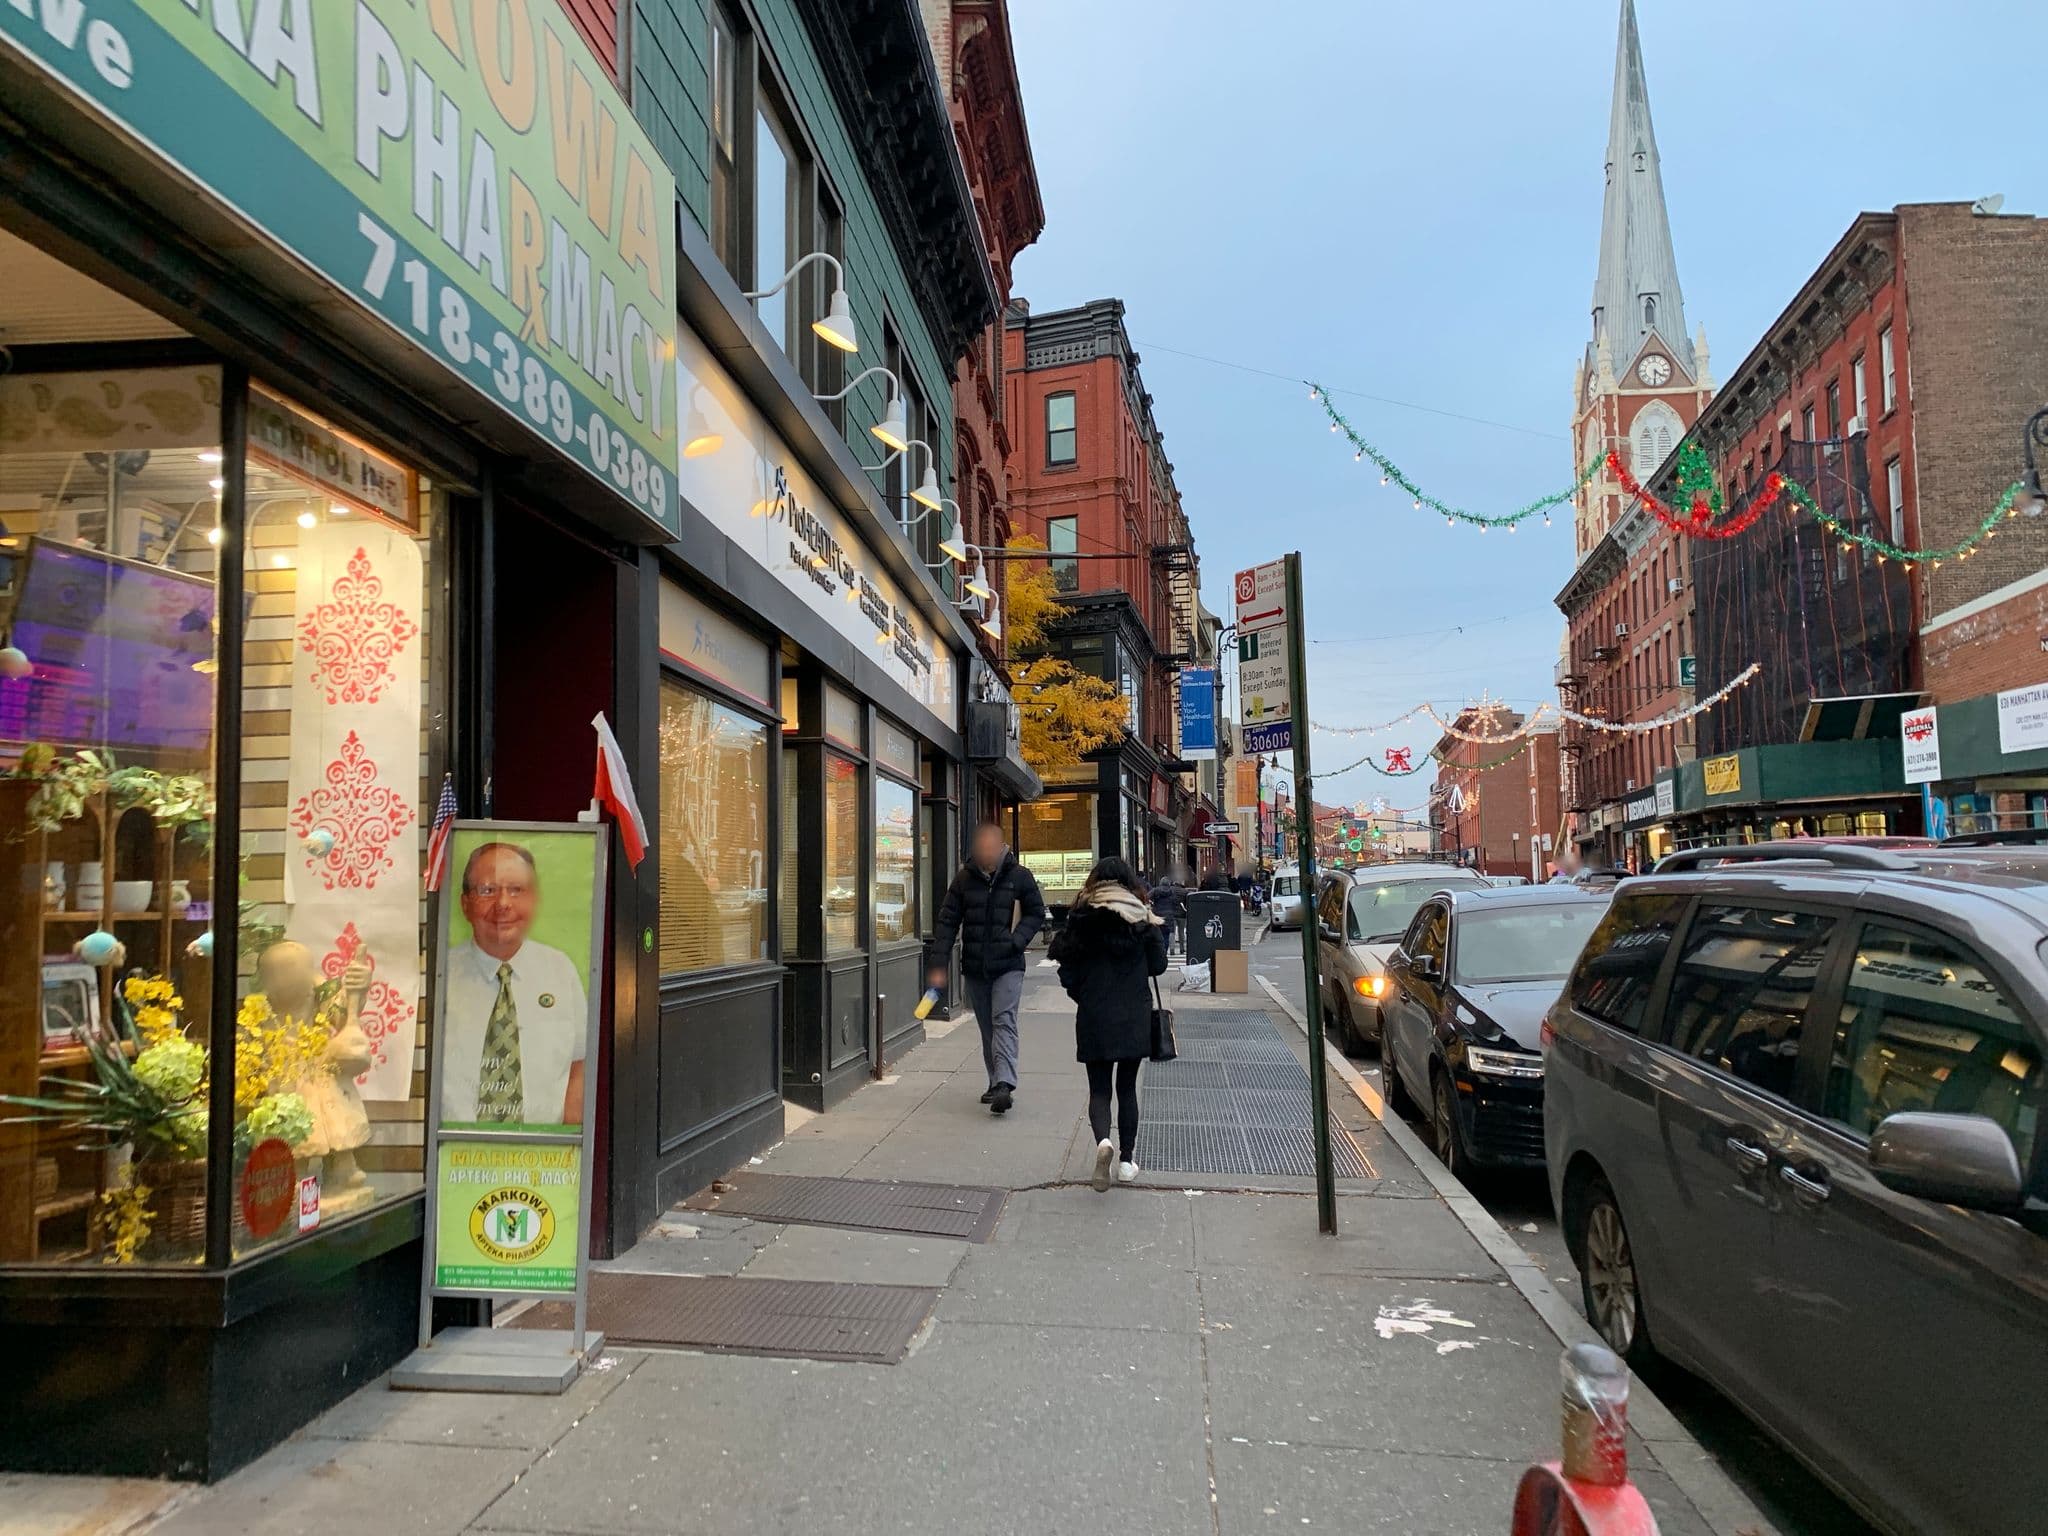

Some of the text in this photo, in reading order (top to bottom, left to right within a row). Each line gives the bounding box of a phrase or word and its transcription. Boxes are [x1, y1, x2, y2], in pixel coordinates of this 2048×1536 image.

[0, 0, 133, 88] ve
[354, 2, 664, 440] PHARMACY
[359, 213, 666, 518] 718-389-0389
[1245, 634, 1252, 658] 1
[1260, 637, 1282, 649] metered
[1260, 648, 1279, 660] parking
[1243, 669, 1264, 682] 8:30am
[1270, 666, 1283, 677] 7pm
[1243, 678, 1286, 694] Except Sunday
[2010, 690, 2042, 707] MANHATTAN
[1906, 722, 1932, 734] ARSENAL
[1252, 731, 1290, 752] 306019
[451, 1150, 577, 1169] MARKOWA
[449, 1170, 579, 1187] APTEKA PHARMACY
[477, 1190, 549, 1218] MARKOWA
[476, 1232, 548, 1260] APTEKA PHARMACY
